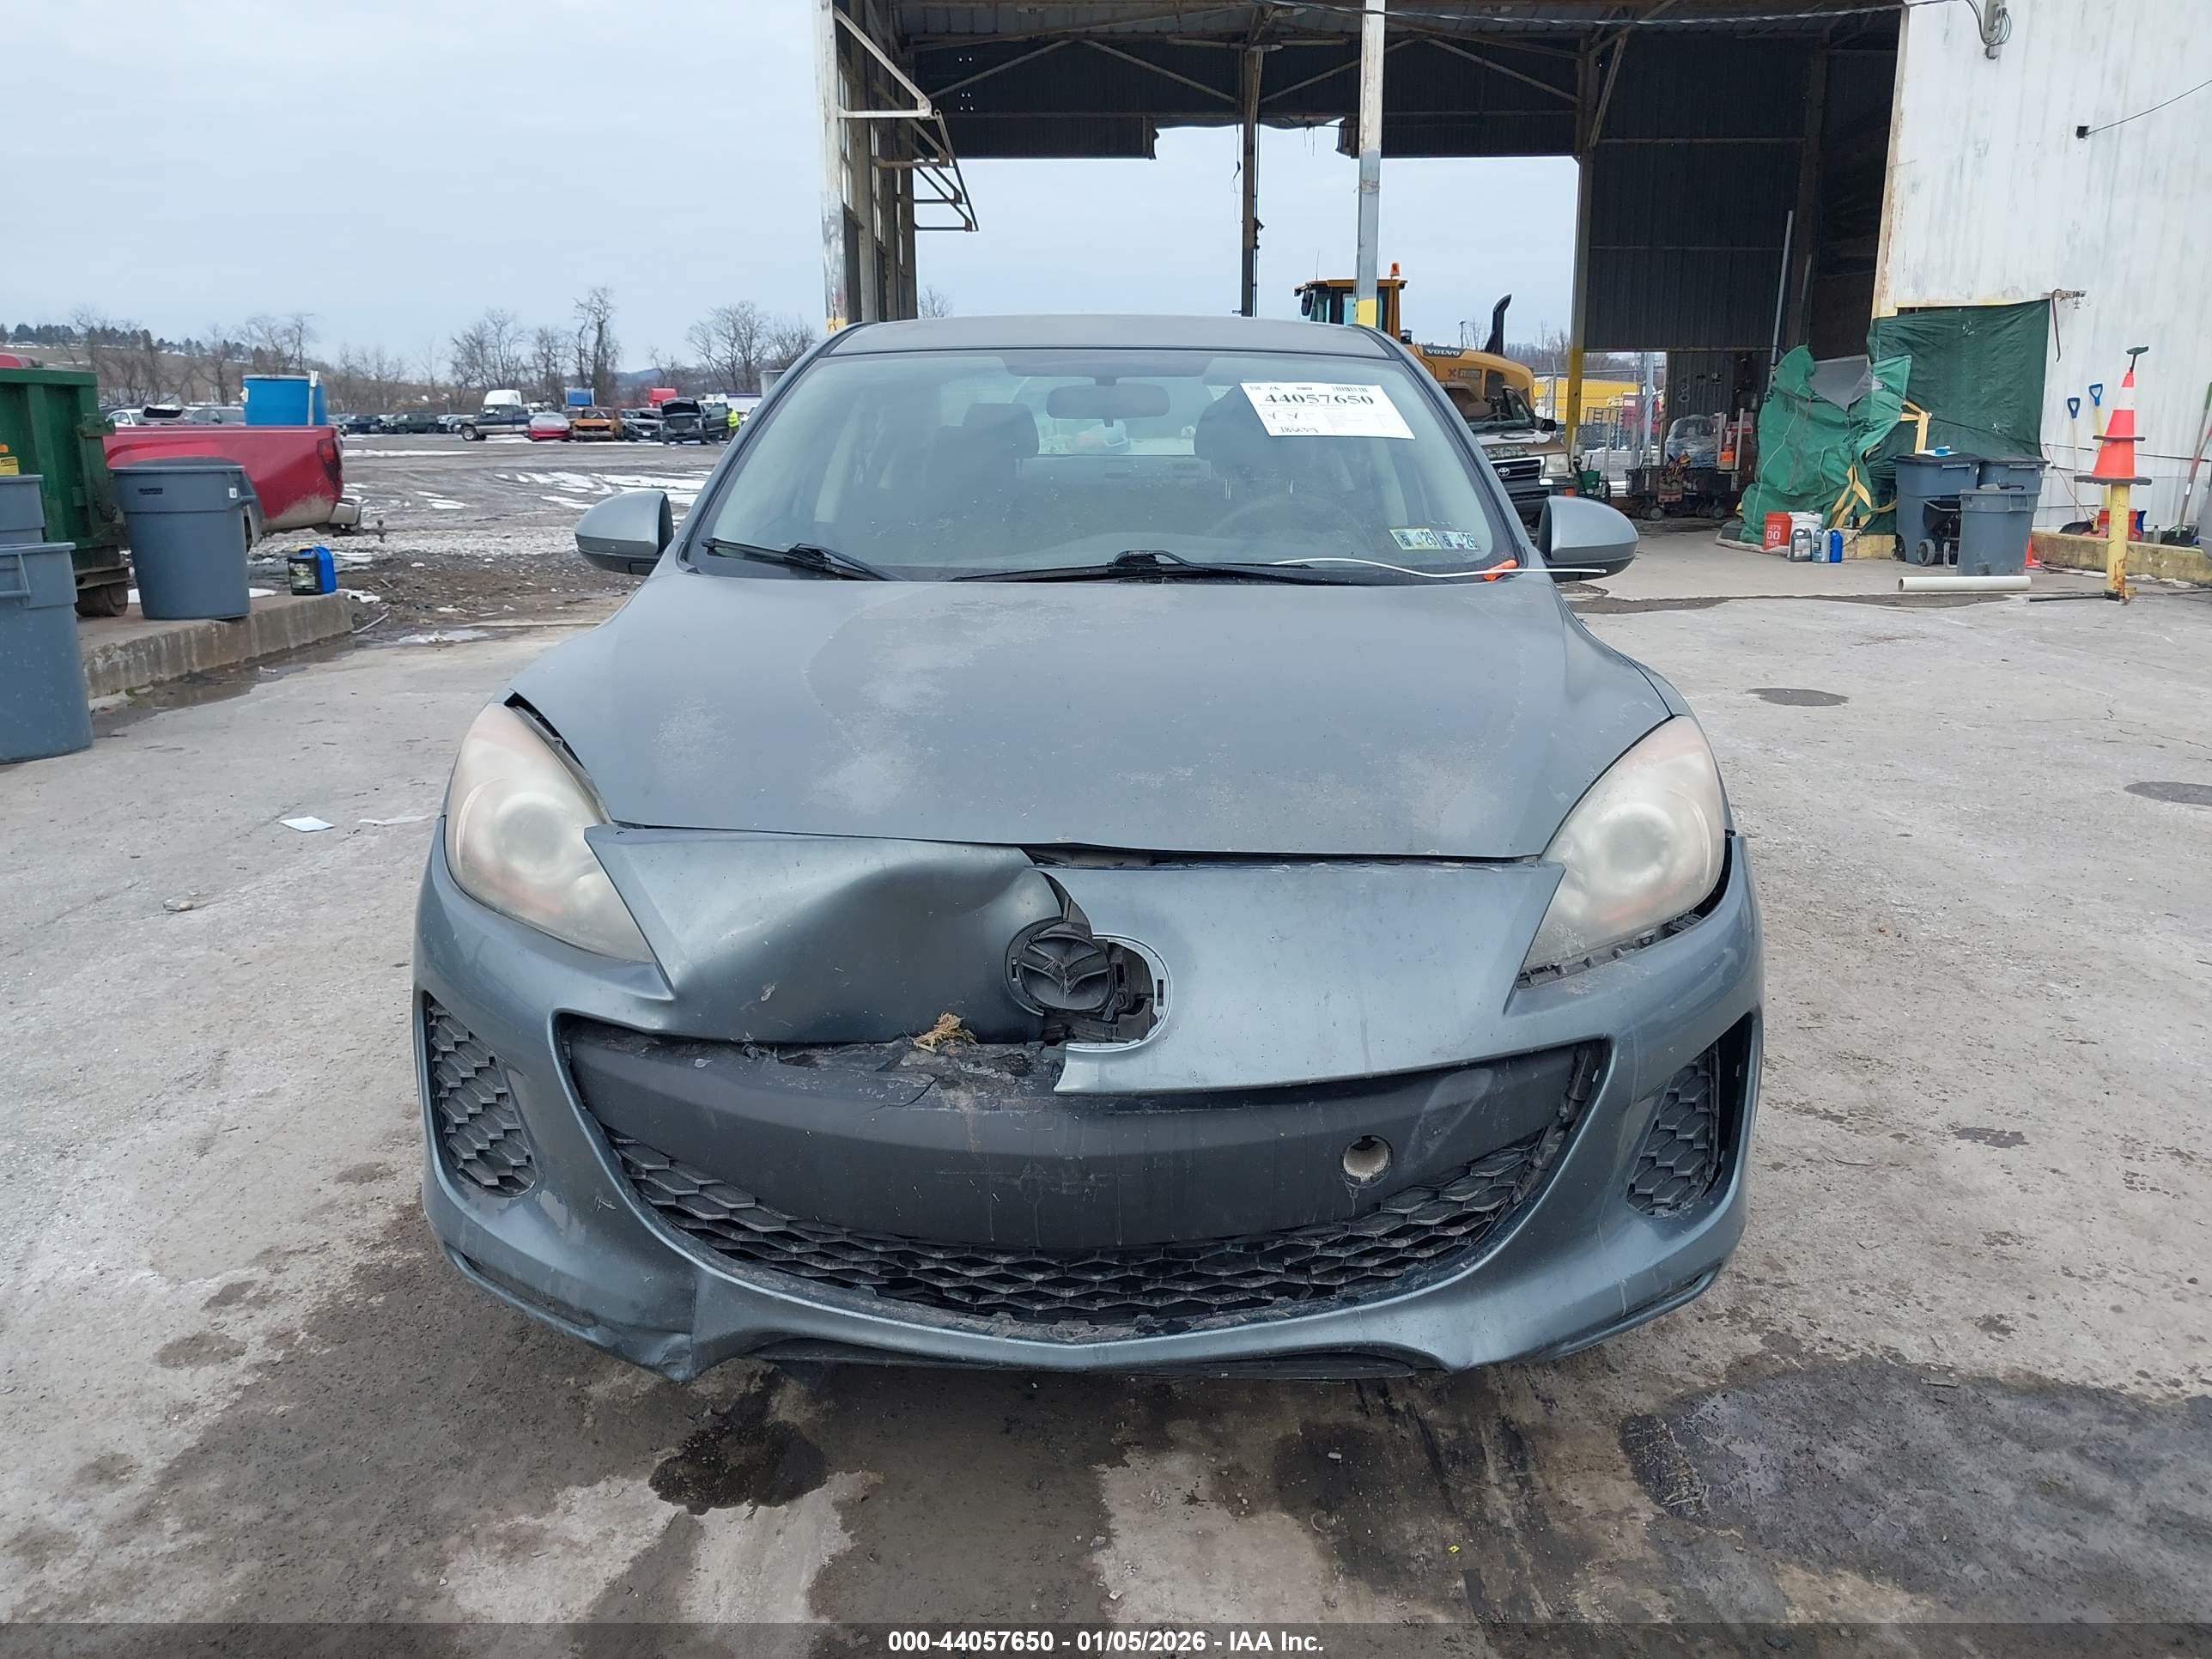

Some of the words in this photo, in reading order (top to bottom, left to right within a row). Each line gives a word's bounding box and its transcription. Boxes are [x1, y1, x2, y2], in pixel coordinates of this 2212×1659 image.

[1265, 394, 1374, 405] 44057650
[1766, 530, 1780, 540] DO
[1442, 535, 1453, 548] 5
